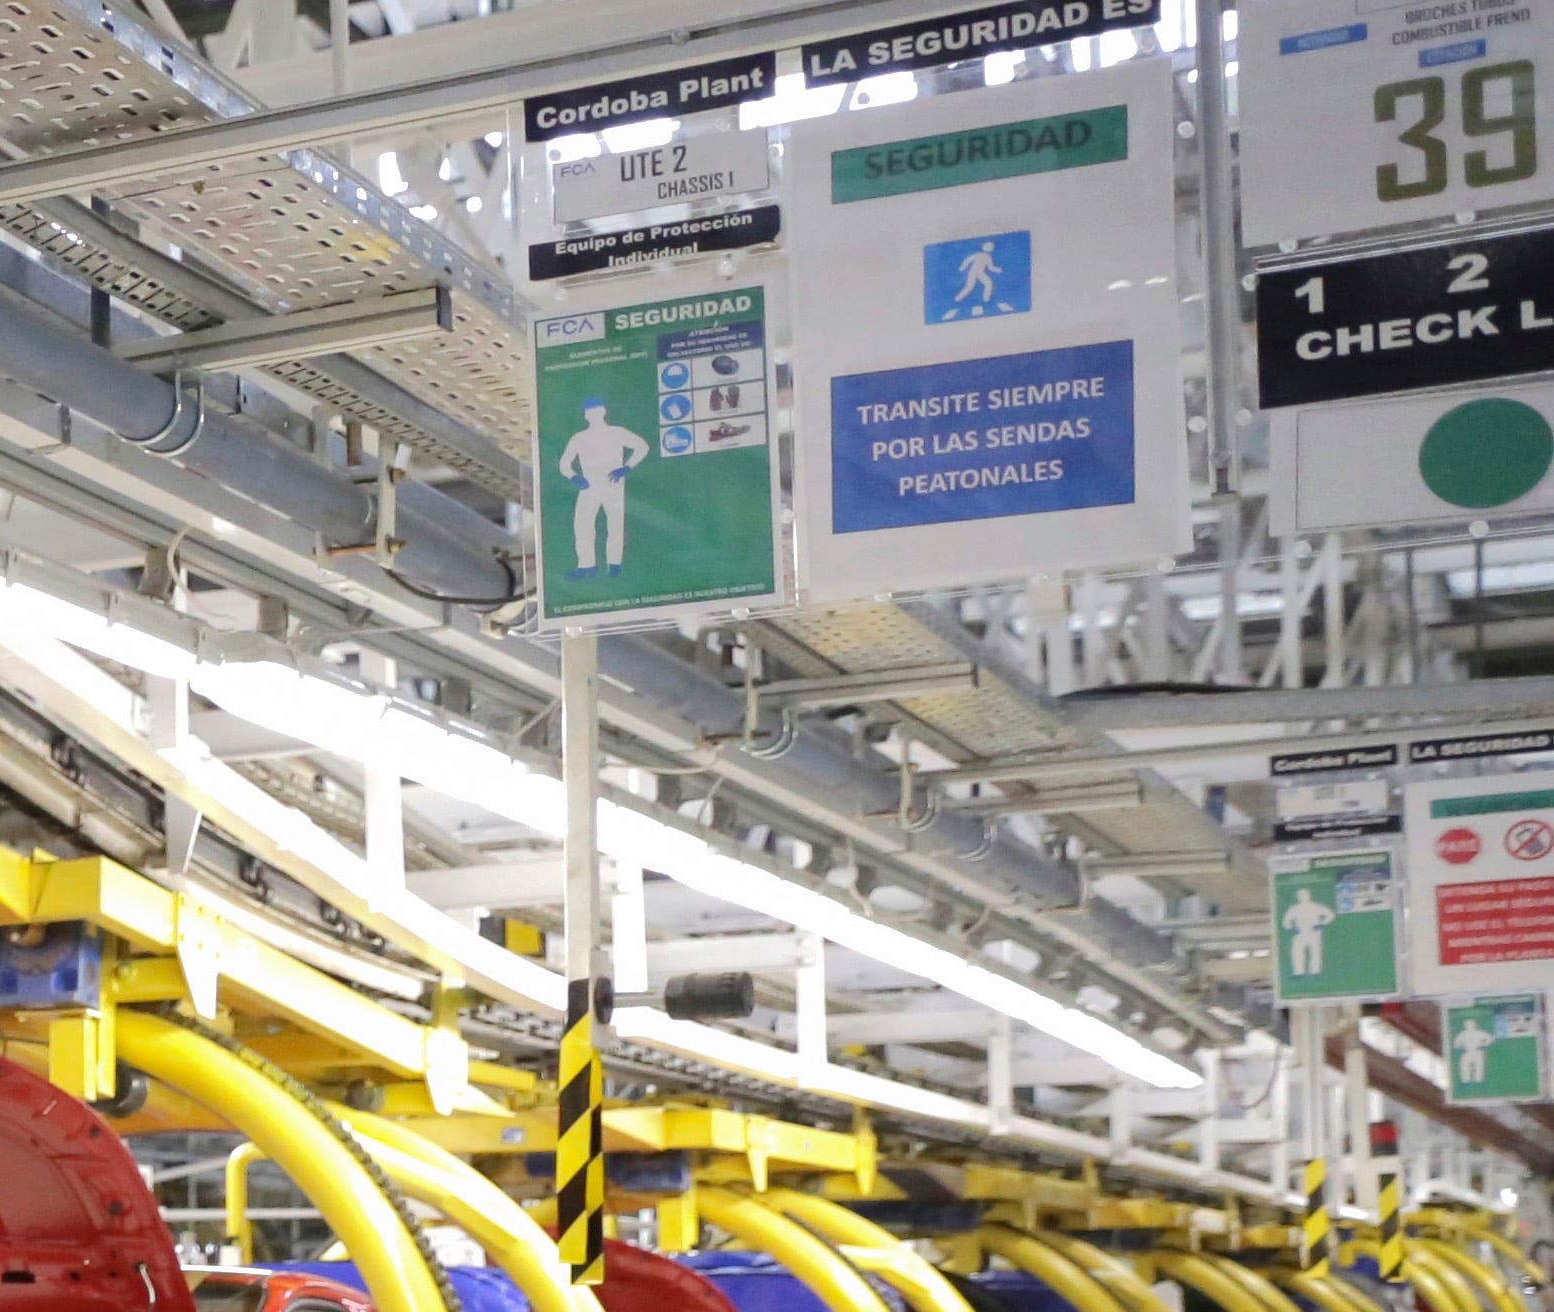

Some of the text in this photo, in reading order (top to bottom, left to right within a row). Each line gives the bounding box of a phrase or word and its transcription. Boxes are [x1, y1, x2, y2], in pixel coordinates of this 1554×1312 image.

[810, 49, 856, 77] LA
[867, 4, 1090, 65] SEGURIDAD
[1391, 20, 1484, 46] COMBUSTIBLE
[536, 66, 765, 129] Cordoba Plant
[863, 119, 1093, 181] SEGURIDAD
[1373, 58, 1537, 203] 39
[561, 161, 596, 177] FCA
[620, 145, 688, 182] UTE 2
[657, 173, 724, 200] CHASSIS
[554, 212, 753, 256] Equipo de Protección
[608, 242, 700, 267] Individual
[1295, 252, 1490, 314] 1 2
[546, 317, 595, 339] FCA
[614, 295, 752, 331] SEGURIDAD
[1295, 305, 1500, 361] CHECK
[856, 376, 1106, 425] TRANSITE SIEMPRE
[872, 417, 1091, 461] POR LAS SENDAS
[898, 460, 1064, 496] PEATONALES
